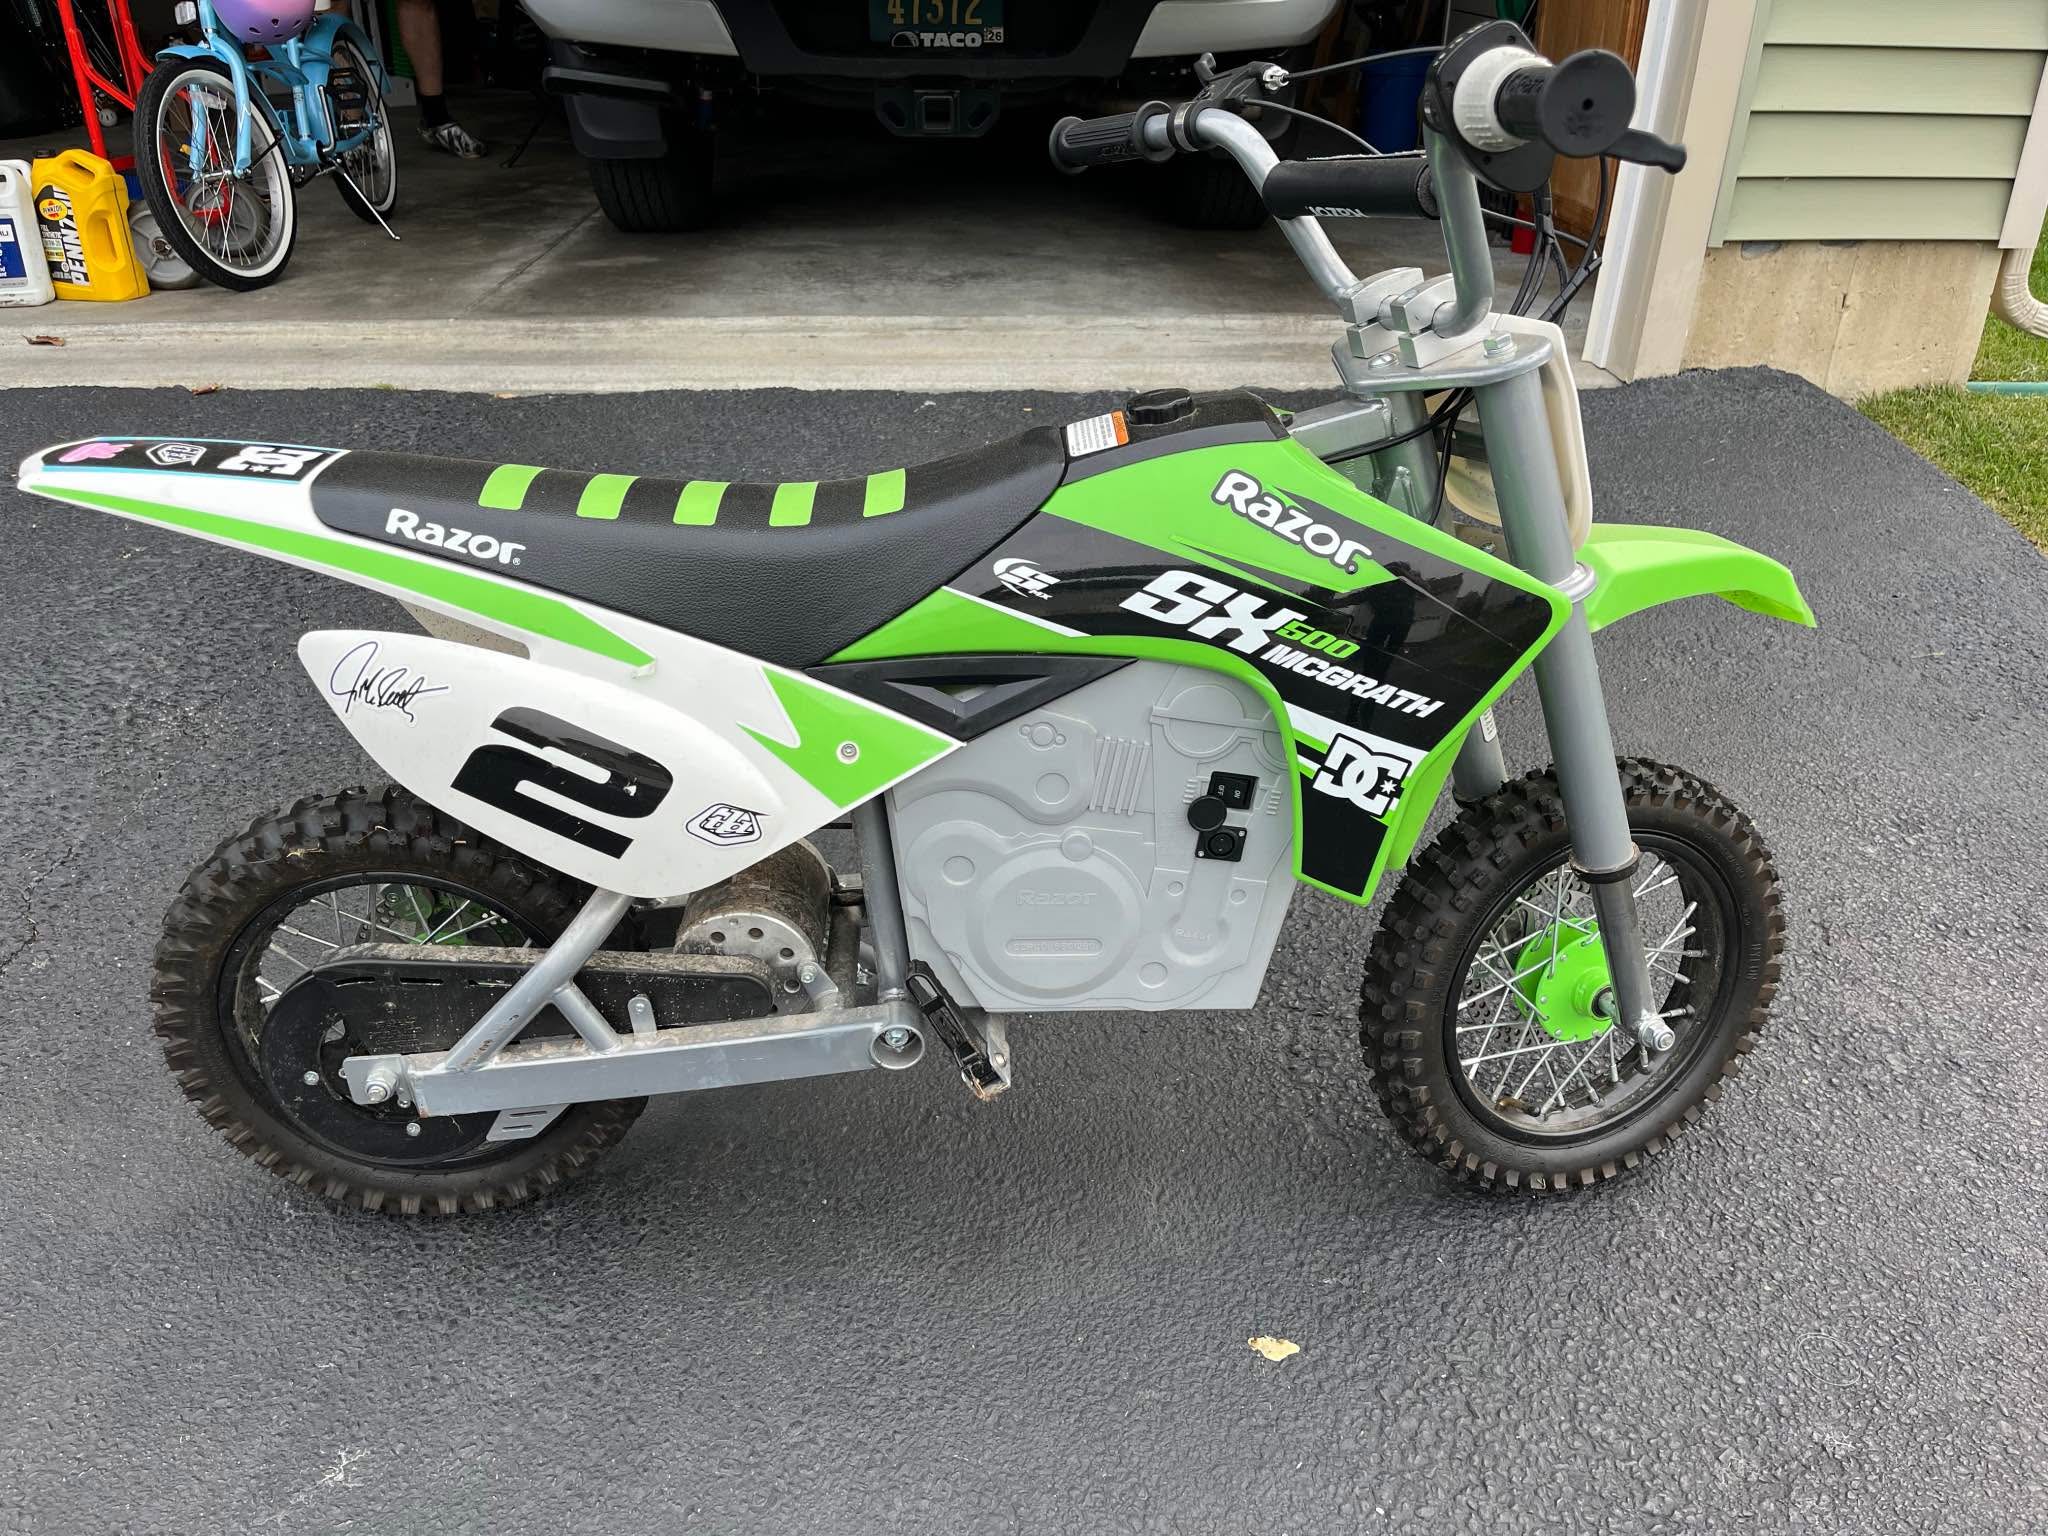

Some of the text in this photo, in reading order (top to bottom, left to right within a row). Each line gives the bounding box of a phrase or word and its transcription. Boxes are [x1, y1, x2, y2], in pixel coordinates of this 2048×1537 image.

[920, 32, 982, 47] TACO
[989, 31, 1002, 40] 26
[385, 508, 526, 564] Razor
[1213, 471, 1373, 567] Razor
[1119, 570, 1360, 658] SX 500
[1260, 644, 1445, 719] MCGRATH
[451, 706, 674, 860] 2
[1312, 735, 1411, 817] DC
